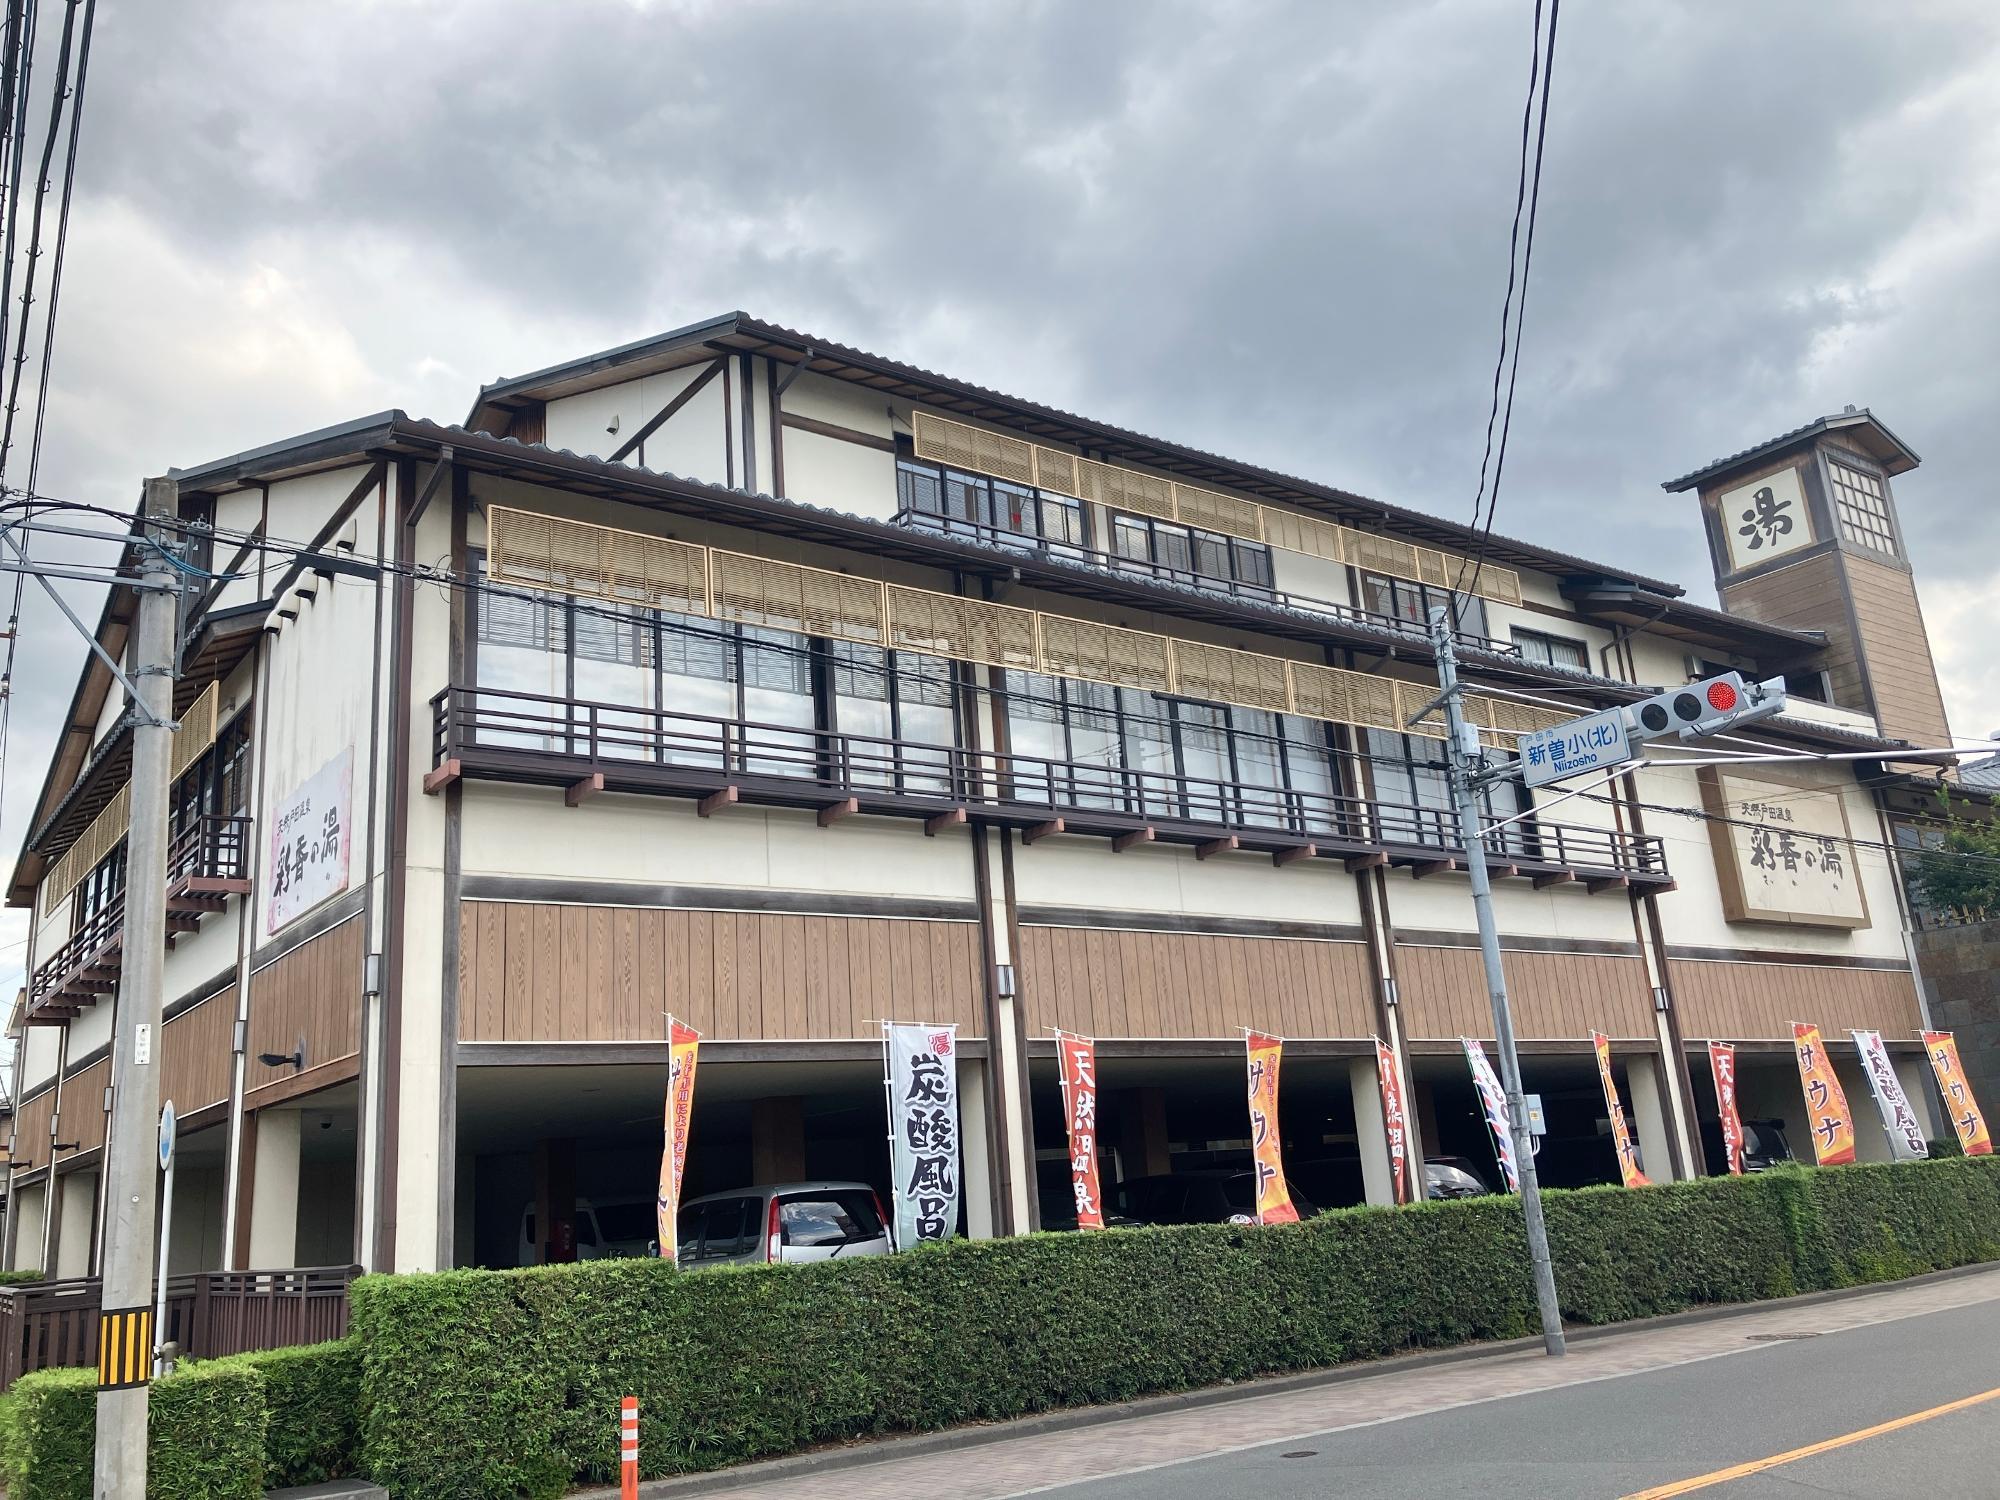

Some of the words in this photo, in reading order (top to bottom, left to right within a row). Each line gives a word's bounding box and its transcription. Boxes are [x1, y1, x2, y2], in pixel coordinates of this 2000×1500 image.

[1738, 486, 1793, 550] 湯
[1528, 722, 1618, 767] 新曽小(北)
[1553, 753, 1598, 773] Niizosho
[1741, 802, 1795, 822] 天然戸田温泉
[273, 805, 340, 897] 彩香の湯
[1750, 826, 1843, 880] 彩香の湯
[931, 1033, 951, 1055] 湯
[1800, 1044, 1841, 1149] サウナ
[1867, 1048, 1925, 1152] 炭酸風呂
[1936, 1048, 1978, 1139] サウナ
[905, 1053, 953, 1240] 炭酸風呂
[1071, 1051, 1098, 1215] 天然温泉
